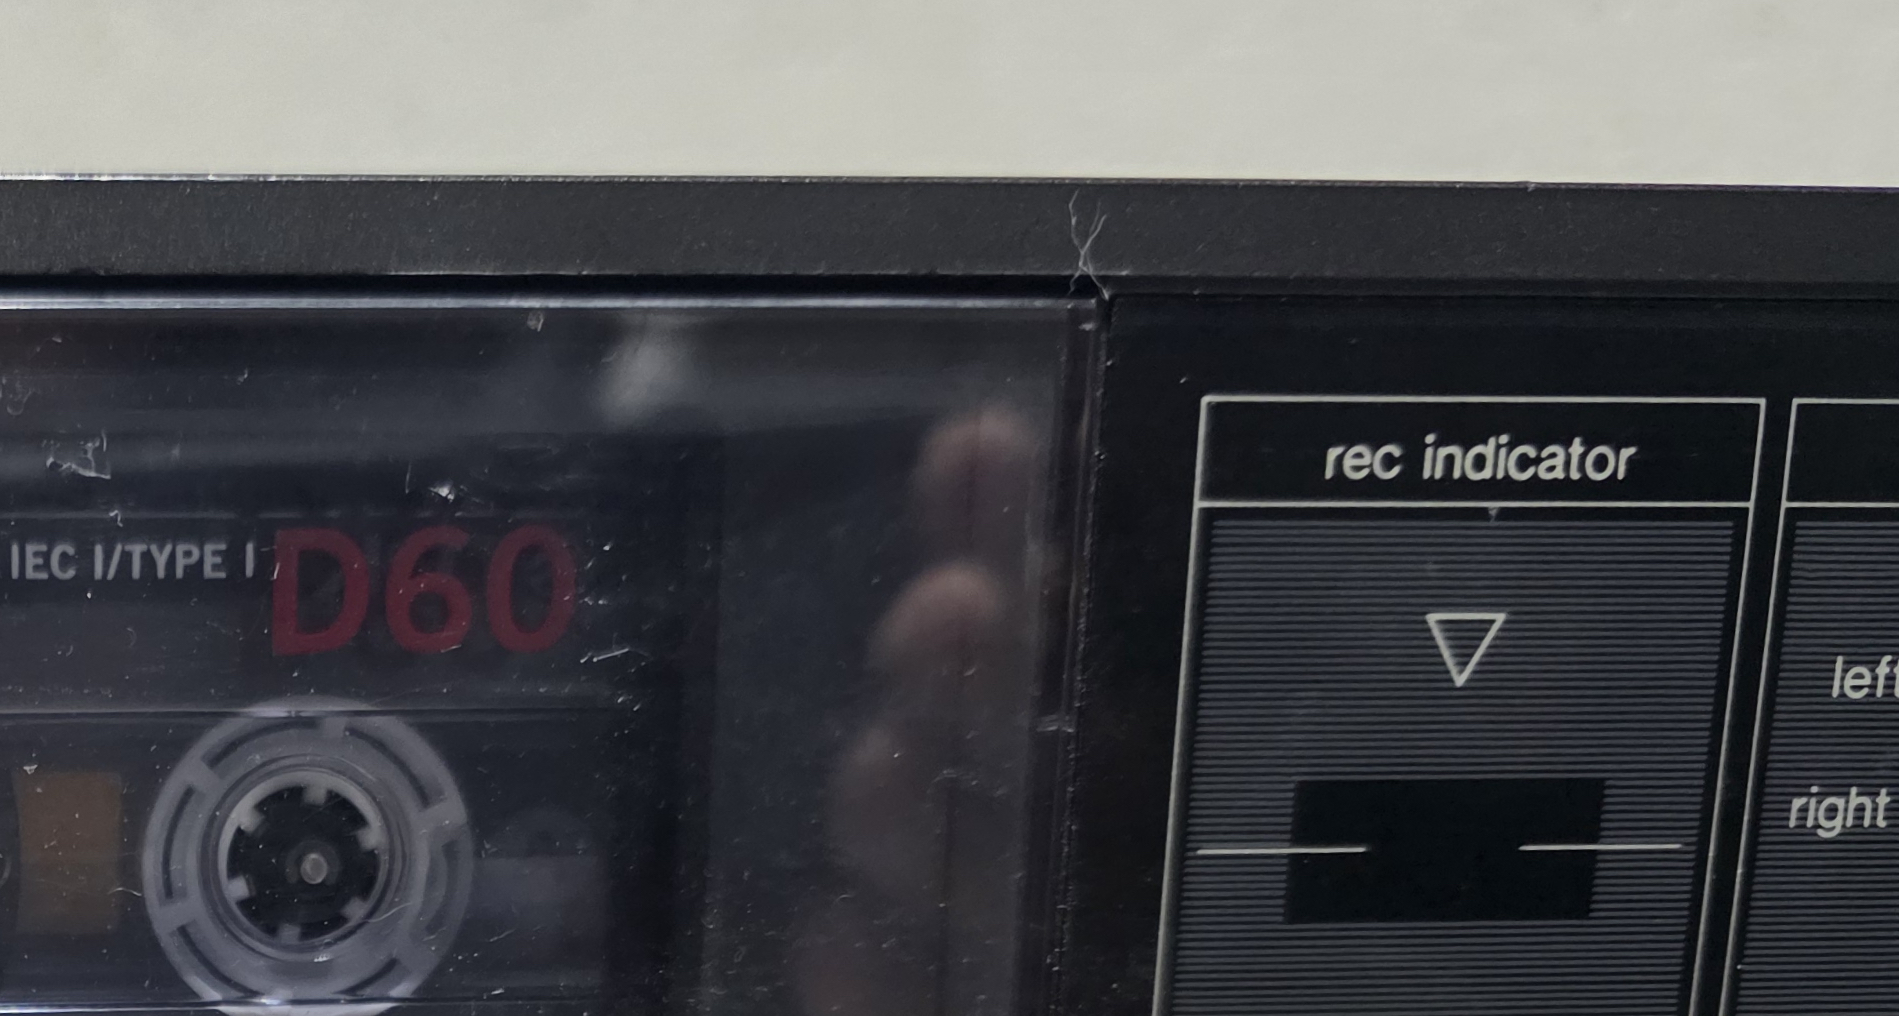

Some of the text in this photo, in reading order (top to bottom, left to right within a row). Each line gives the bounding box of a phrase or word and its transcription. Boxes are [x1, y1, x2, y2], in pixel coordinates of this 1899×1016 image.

[1324, 433, 1637, 481] rec indicator
[11, 542, 77, 580] IEC
[93, 542, 227, 581] I/TYPE
[271, 525, 577, 656] D60
[1788, 785, 1892, 839] right
